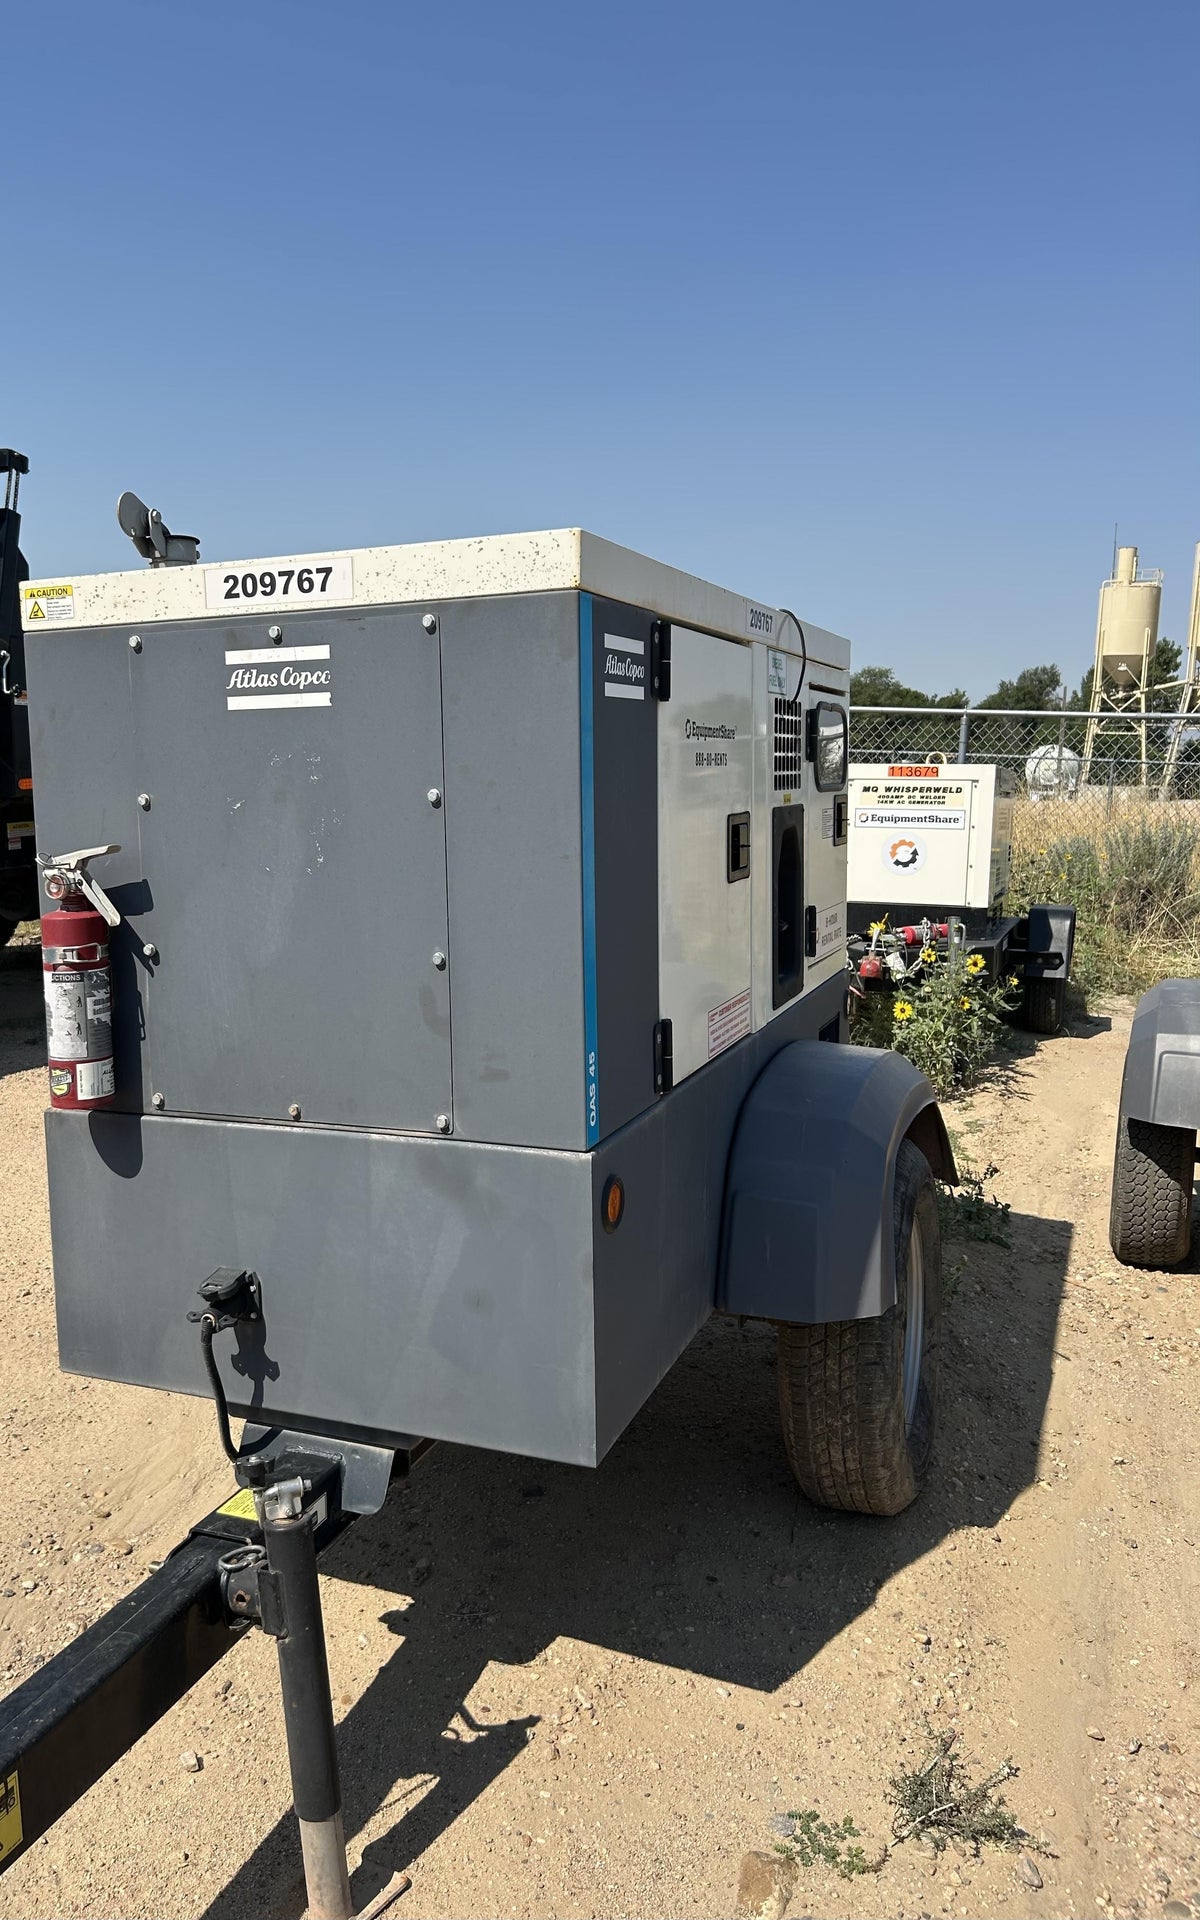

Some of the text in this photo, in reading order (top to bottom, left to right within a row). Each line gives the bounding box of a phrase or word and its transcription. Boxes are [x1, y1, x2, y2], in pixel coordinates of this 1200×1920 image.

[36, 587, 68, 598] CAUTION
[223, 566, 333, 600] 209767
[749, 608, 773, 633] 209767
[225, 666, 331, 690] Atlas Copco
[604, 654, 645, 682] Atlas Copco
[691, 721, 736, 742] EquipmentShare
[888, 766, 939, 778] 113679
[862, 785, 963, 795] MQ WHISPERWELD
[870, 813, 960, 825] EquipmentShare
[588, 1051, 596, 1077] 45
